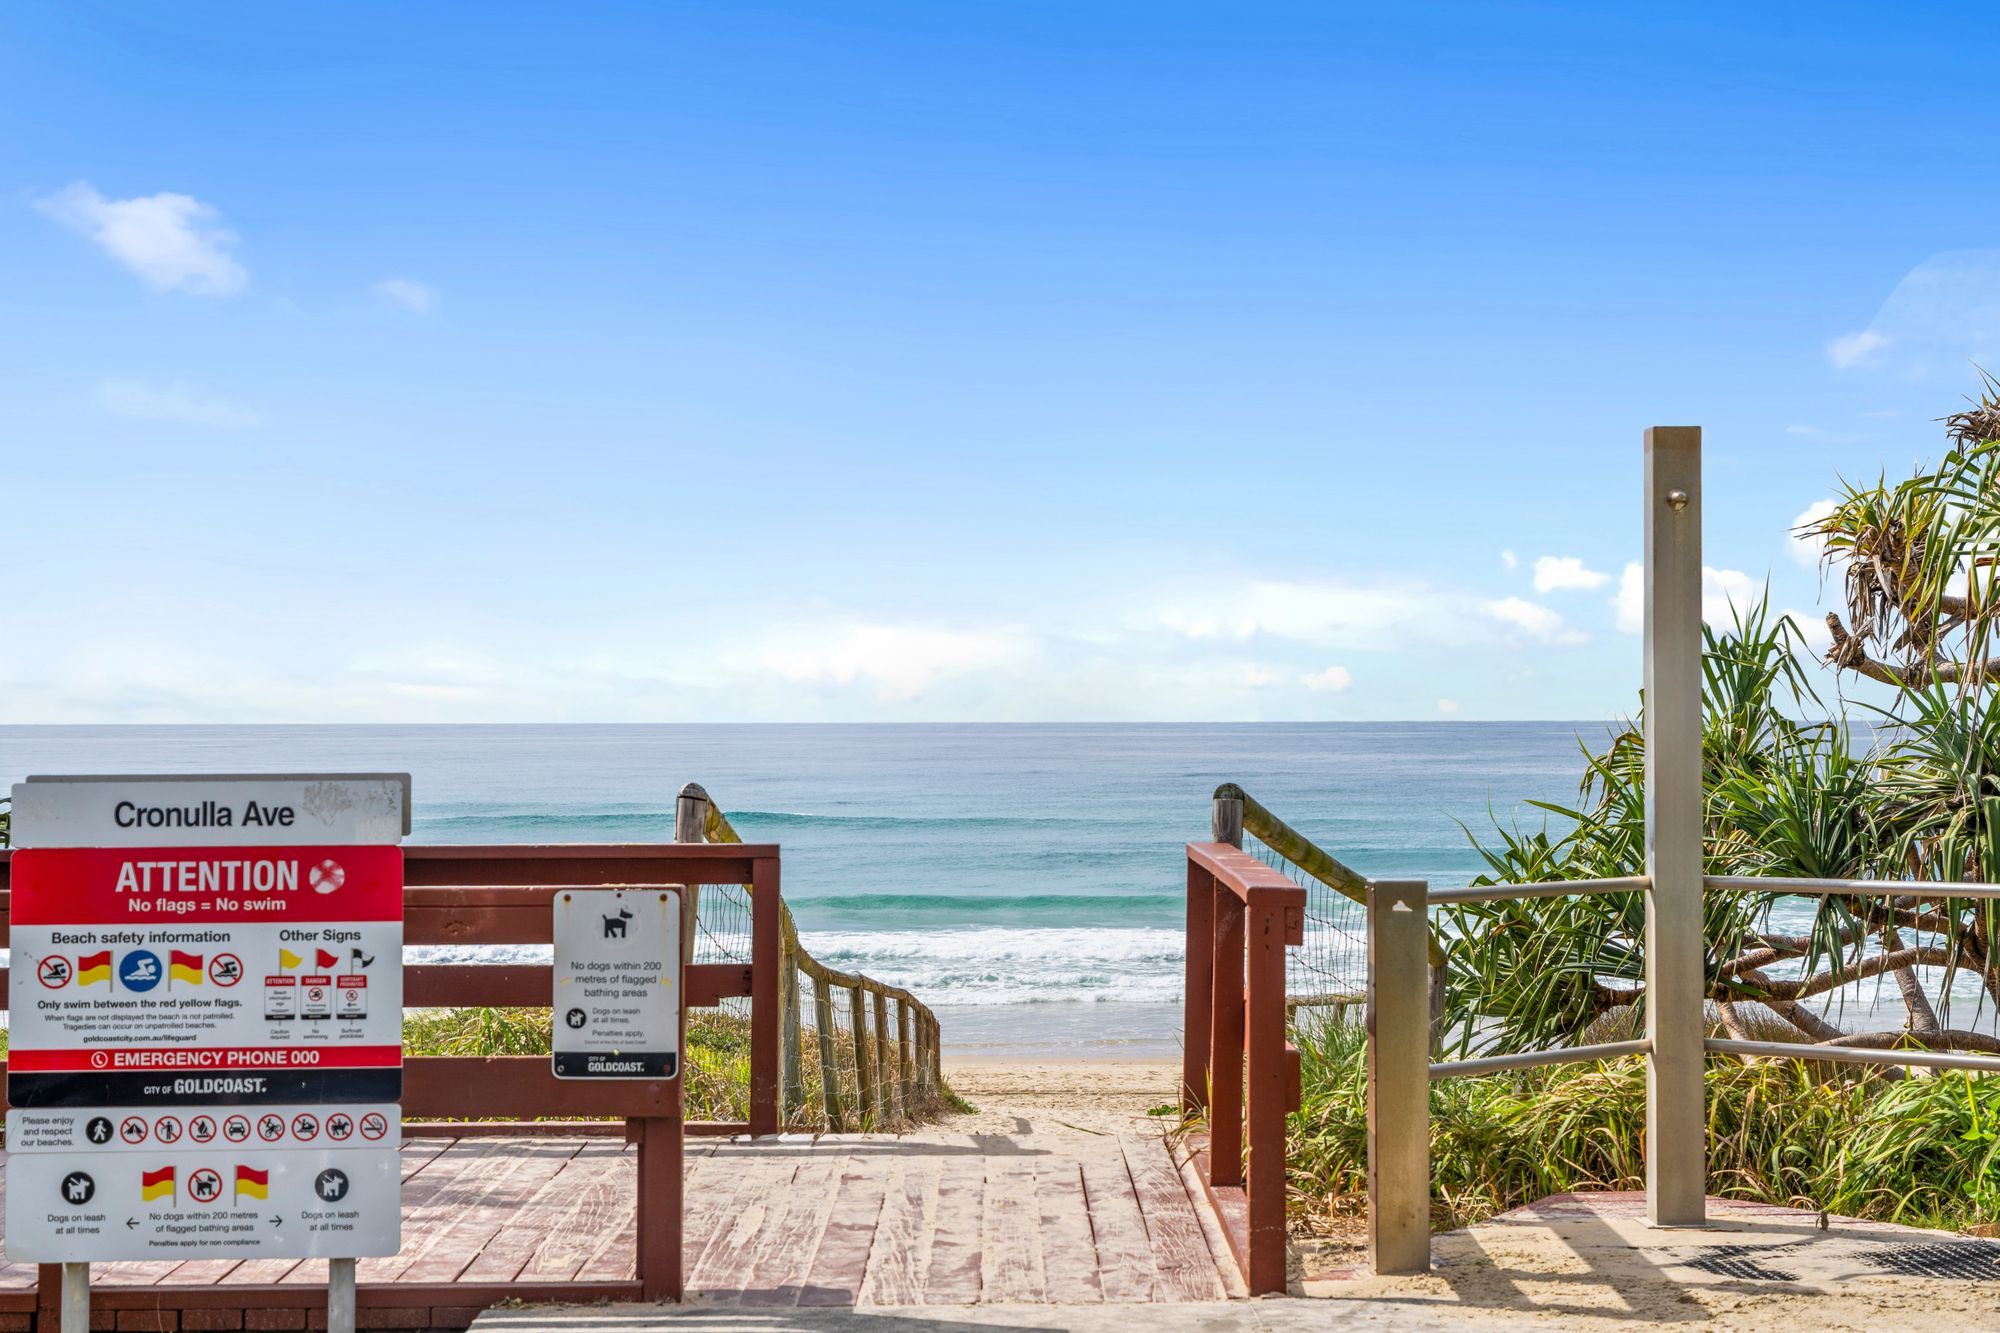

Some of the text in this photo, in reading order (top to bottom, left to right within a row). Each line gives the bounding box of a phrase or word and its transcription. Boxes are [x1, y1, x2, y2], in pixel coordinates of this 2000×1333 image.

[114, 801, 295, 828] Cronulla Ave
[115, 860, 298, 893] ATTENTION
[128, 899, 150, 912] No
[156, 898, 196, 914] flags
[216, 898, 239, 911] No
[244, 898, 286, 911] swim
[52, 931, 231, 945] Beach safety information
[280, 929, 361, 943] Other Signs
[571, 962, 662, 972] No dogs within 200
[575, 975, 657, 986] metres of flagged
[584, 988, 620, 999] bathing
[37, 999, 243, 1011] Only swim between the red yellow flags.
[592, 1007, 610, 1015] Dogs
[45, 1014, 65, 1022] When
[67, 1014, 83, 1023] flags
[111, 1013, 144, 1023] displayed
[202, 1013, 236, 1022] patrolled.
[63, 1023, 96, 1031] Tragedies
[145, 1022, 183, 1031] unpatrolled
[83, 1034, 197, 1044] goldcoastcity.com.au/lifeguard
[114, 1050, 320, 1066] EMERGENCY PHONE 000
[144, 1086, 160, 1095] CITY
[162, 1086, 172, 1094] OF
[22, 1116, 75, 1127] Please enjoy
[23, 1128, 73, 1138] and respect
[37, 1138, 74, 1147] beaches.
[47, 1214, 68, 1224] Dogs
[84, 1214, 106, 1222] leash
[163, 1212, 184, 1222] dogs
[186, 1212, 210, 1220] within
[301, 1211, 323, 1220] Dogs
[338, 1211, 360, 1219] leash
[66, 1226, 75, 1234] all
[77, 1226, 100, 1234] times
[165, 1224, 197, 1234] flagged
[199, 1224, 230, 1233] bathing
[320, 1223, 328, 1231] all
[331, 1223, 353, 1231] times
[180, 1240, 197, 1248] apply
[223, 1239, 260, 1247] compliance
